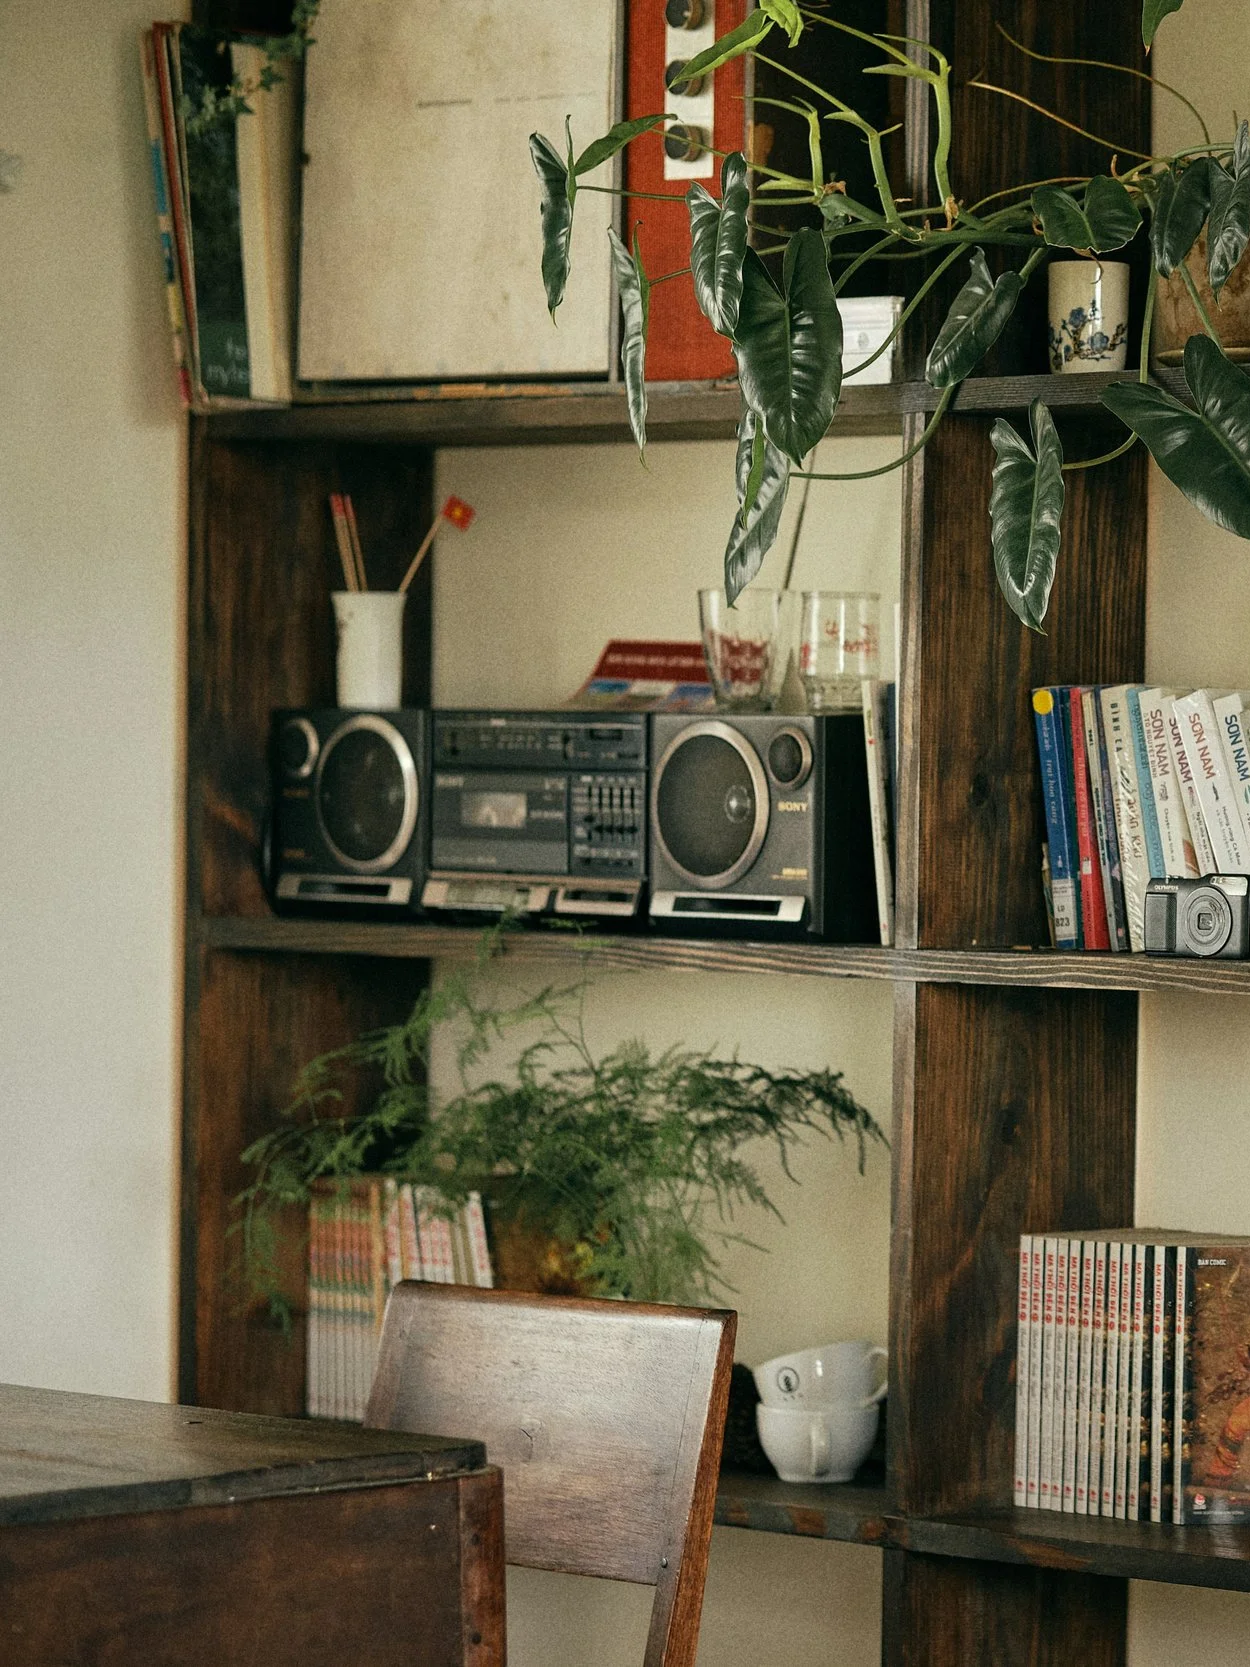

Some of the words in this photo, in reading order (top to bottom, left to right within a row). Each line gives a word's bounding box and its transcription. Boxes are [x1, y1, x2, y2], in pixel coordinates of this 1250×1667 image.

[1155, 743, 1170, 777] NAM
[1176, 749, 1193, 784] NAM
[1197, 745, 1217, 780] NAM
[1233, 747, 1250, 782] NAM
[777, 801, 808, 812] SONY
